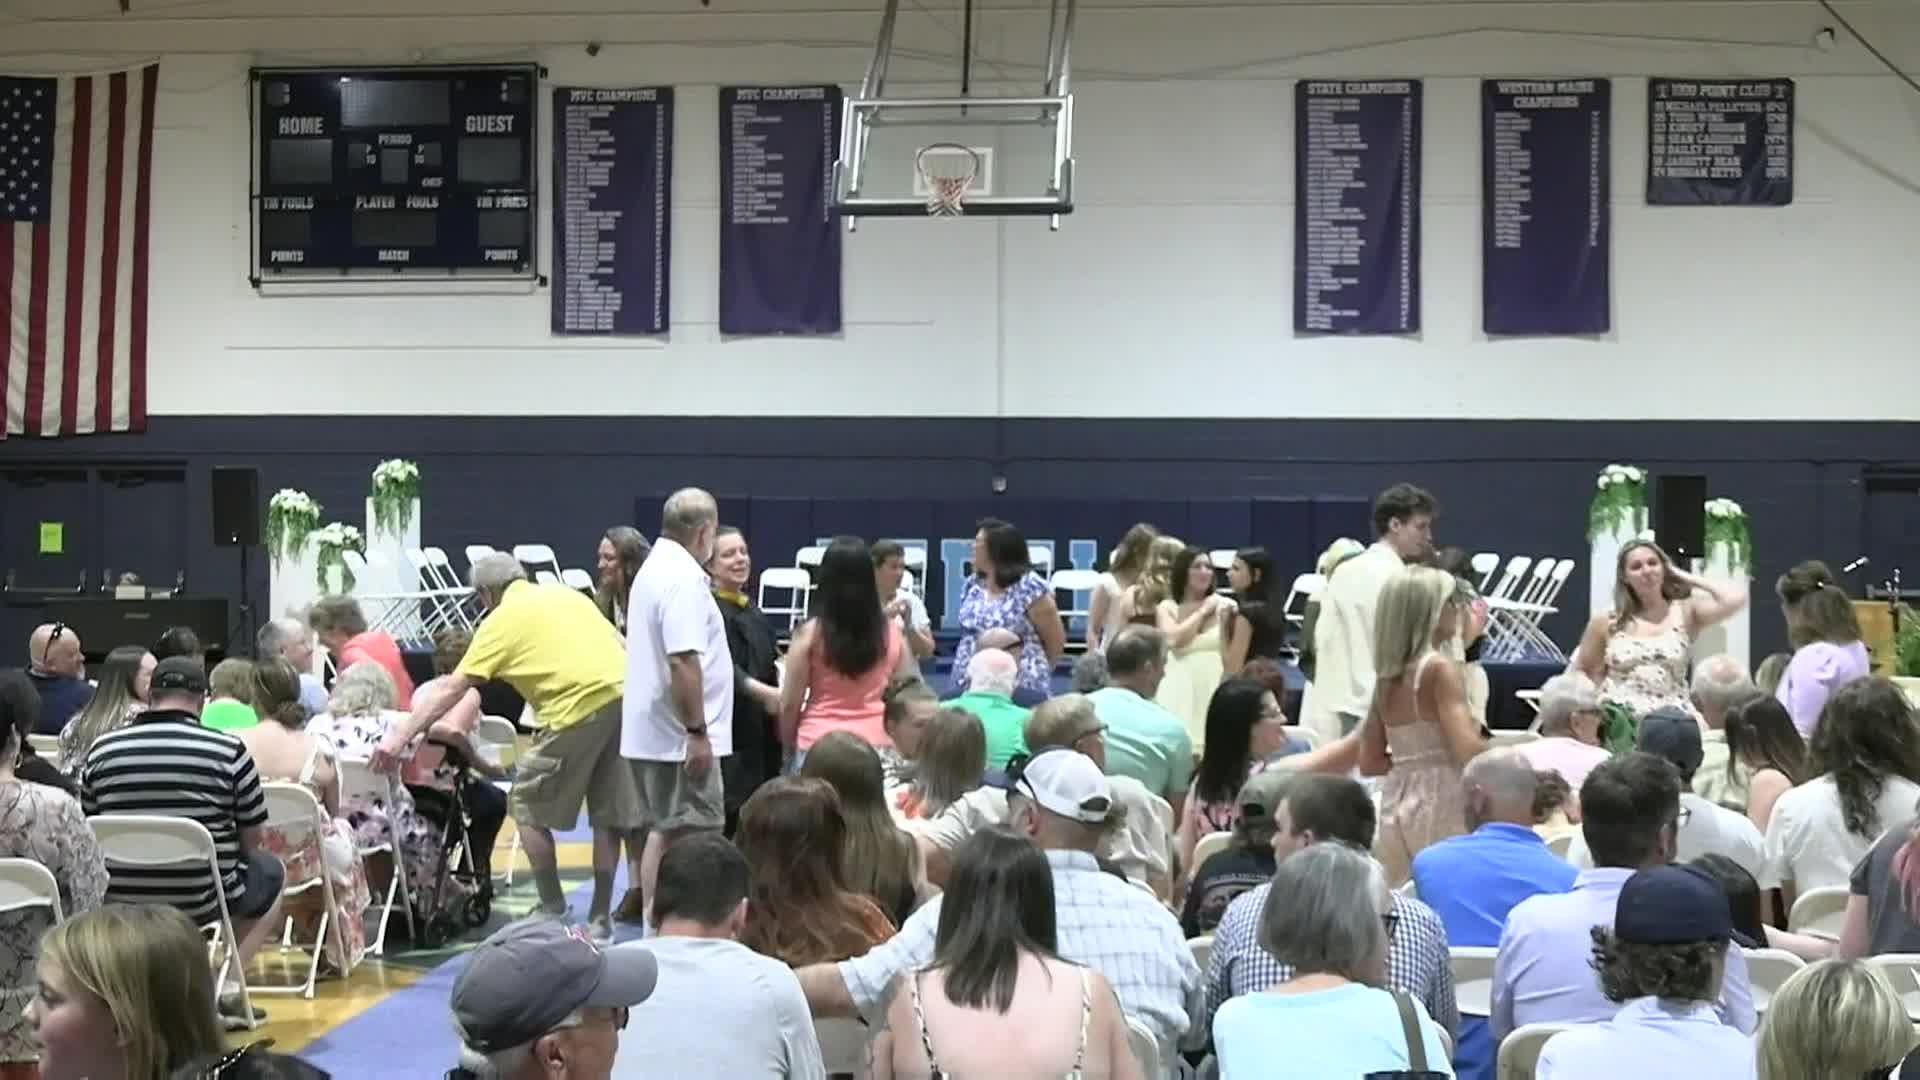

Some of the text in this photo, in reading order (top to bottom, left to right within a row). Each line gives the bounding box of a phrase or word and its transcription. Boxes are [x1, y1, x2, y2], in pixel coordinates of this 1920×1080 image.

[763, 88, 825, 100] CHAMPIONS
[1307, 82, 1410, 95] STATE CHAMPIONS
[1497, 82, 1554, 94] WESTERN
[1700, 84, 1737, 97] POINT
[1739, 83, 1771, 97] CLUB
[570, 89, 657, 102] MVC CHAMPIONS
[1513, 95, 1579, 108] CHAMPIONS
[279, 117, 324, 135] HOME
[465, 114, 515, 133] GUEST
[282, 197, 315, 210] FOULS
[356, 196, 439, 209] PLAYER FOULS
[271, 250, 304, 262] POINTS
[378, 250, 410, 261] MATCH
[484, 249, 519, 261] POINTS
